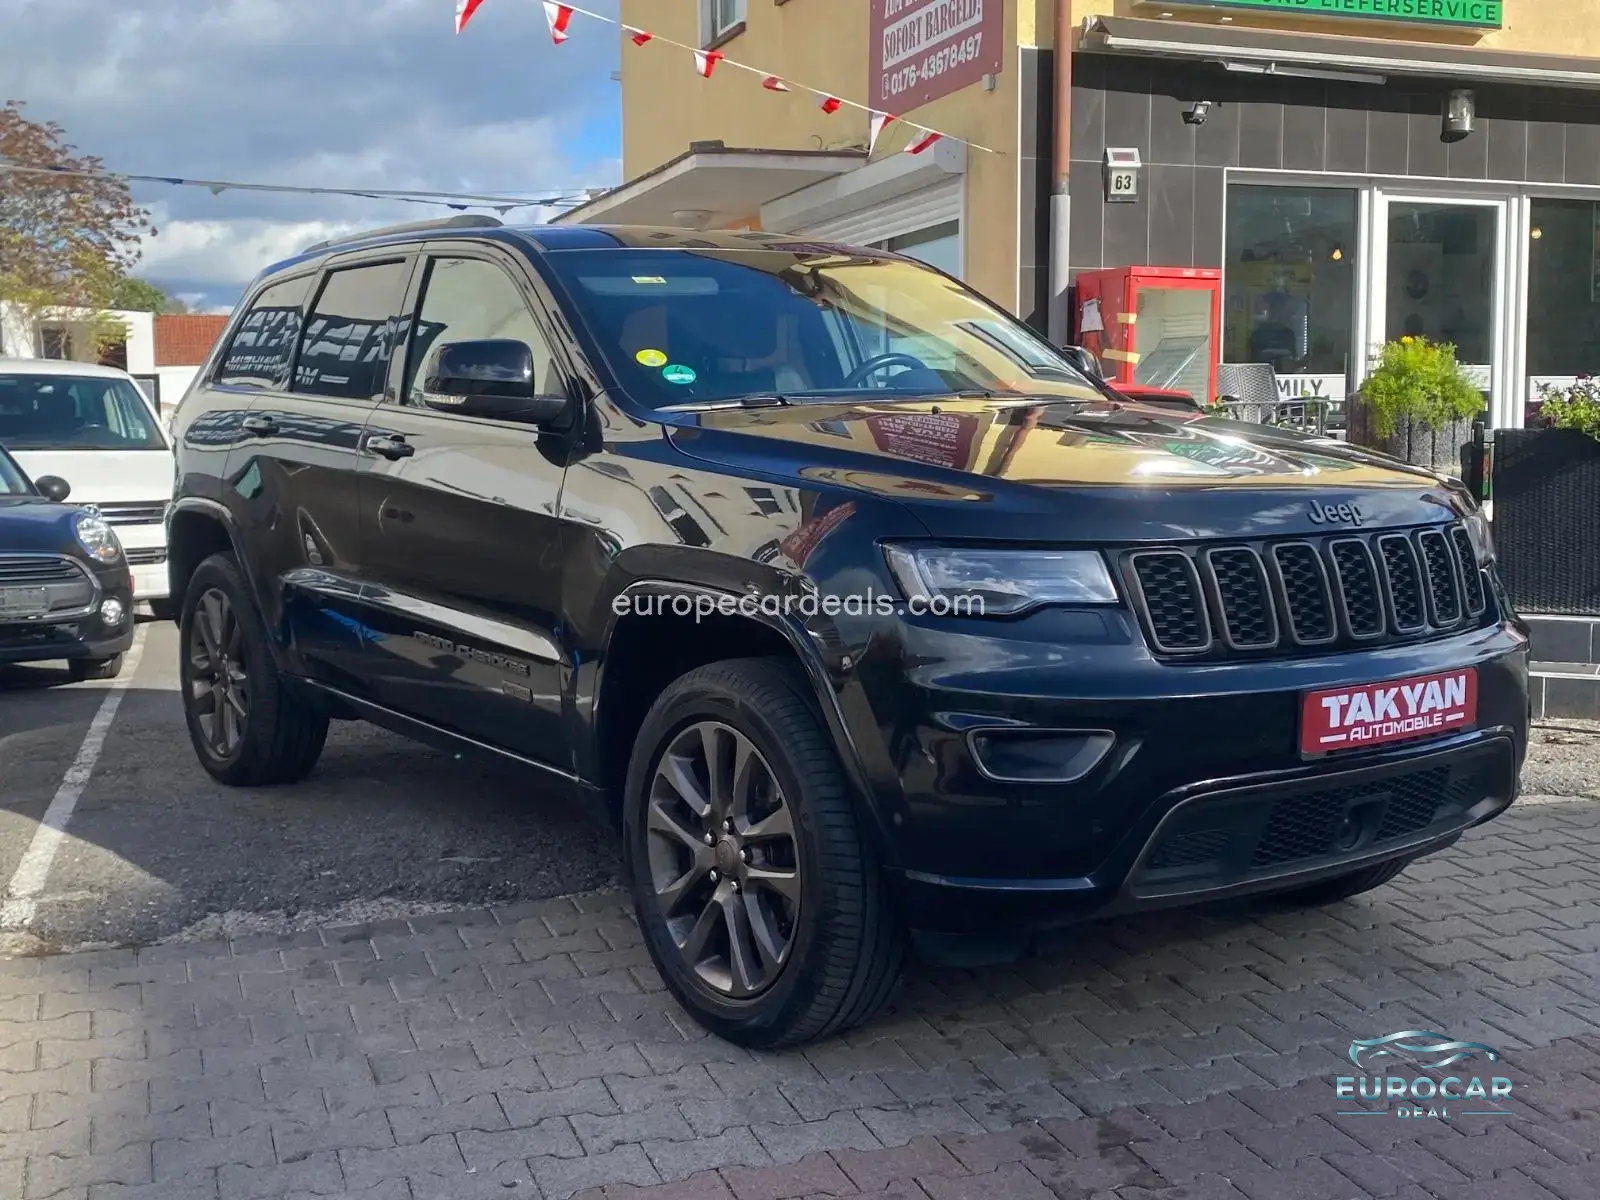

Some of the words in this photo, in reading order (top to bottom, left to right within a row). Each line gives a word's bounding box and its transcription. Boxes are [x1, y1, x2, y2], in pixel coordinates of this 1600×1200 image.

[884, 16, 923, 62] SOFORT
[891, 32, 982, 95] 0176-43678497
[1115, 175, 1132, 190] 63
[1307, 499, 1362, 527] Jeep
[1321, 675, 1466, 728] TAKYAN
[1350, 713, 1443, 741] AUTOMOBILE
